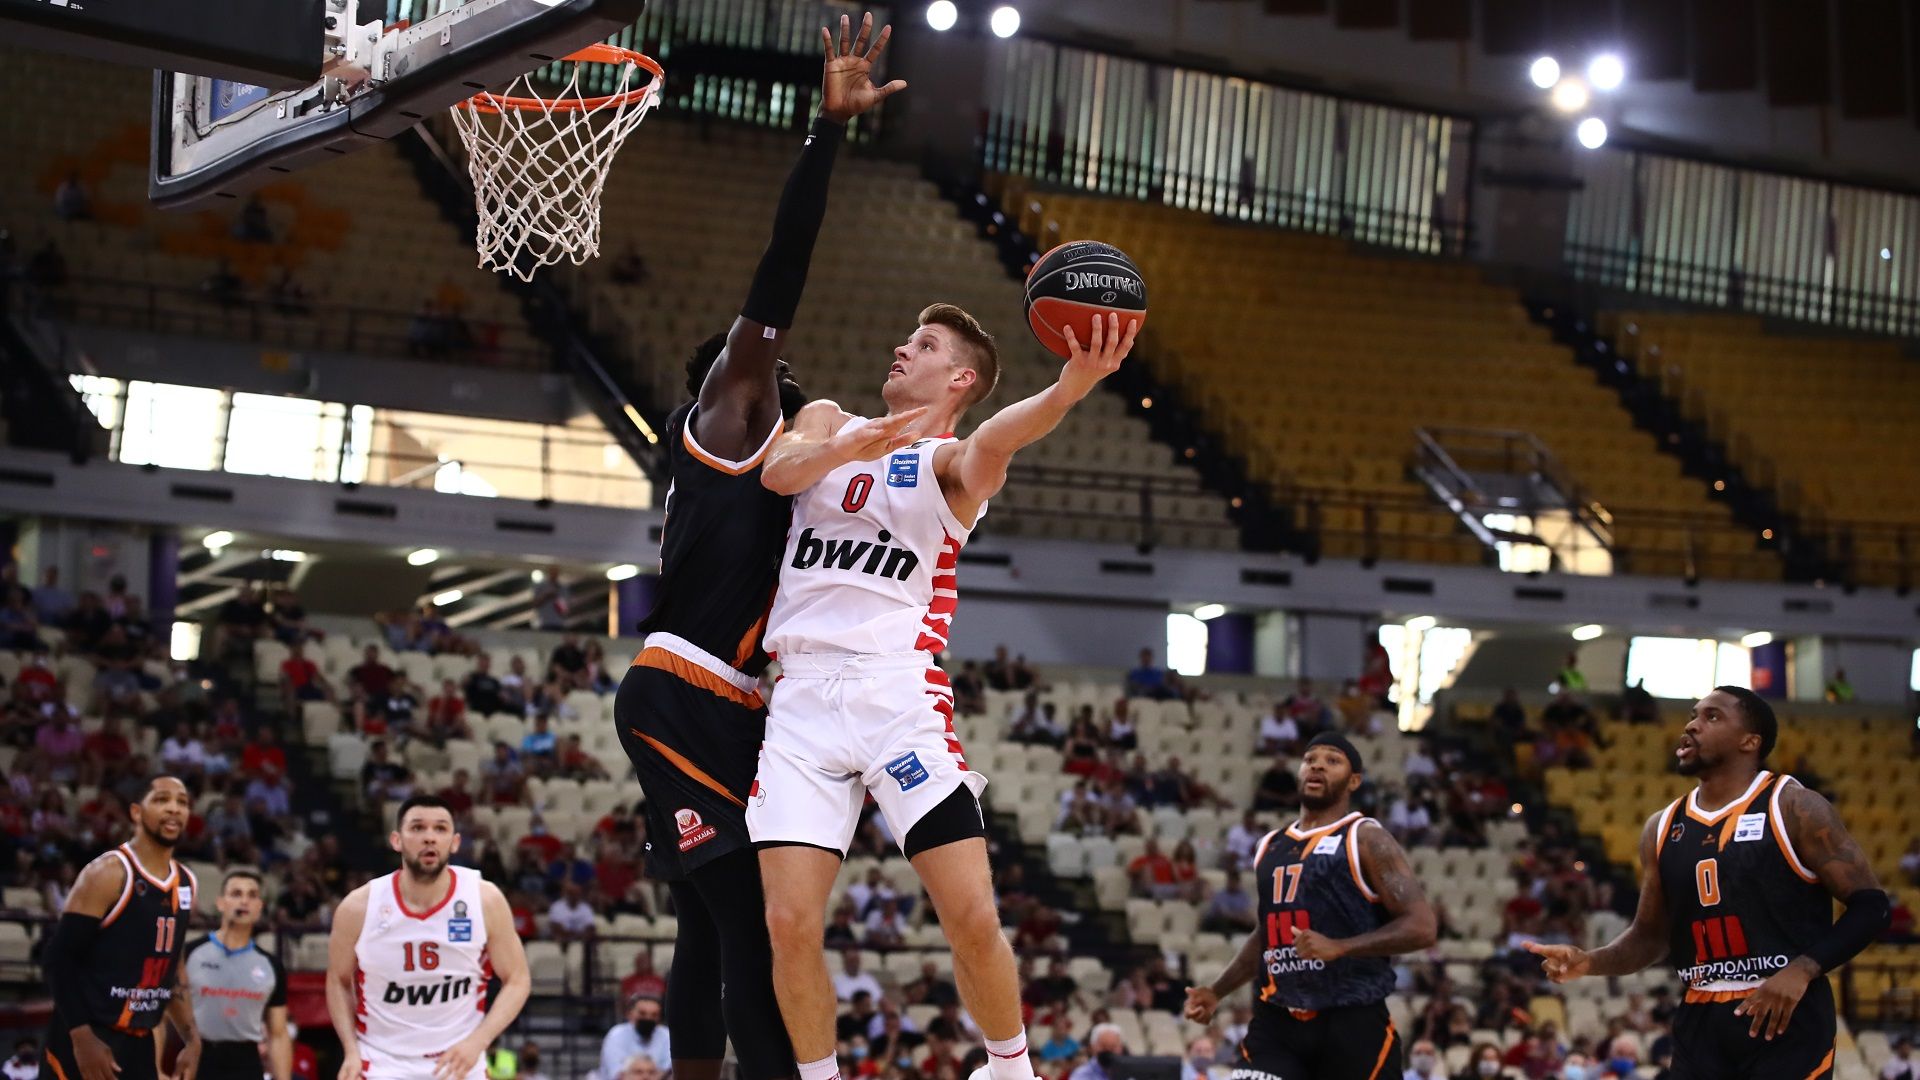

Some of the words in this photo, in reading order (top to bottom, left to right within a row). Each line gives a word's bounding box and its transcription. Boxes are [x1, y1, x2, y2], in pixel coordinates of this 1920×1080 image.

[1065, 271, 1143, 300] SPALDING
[841, 473, 875, 513] 0
[791, 528, 919, 581] bwin
[1272, 863, 1303, 904] 17
[1696, 858, 1721, 907] 0
[155, 916, 176, 952] 11
[403, 941, 440, 972] 16
[383, 975, 471, 1006] bwin
